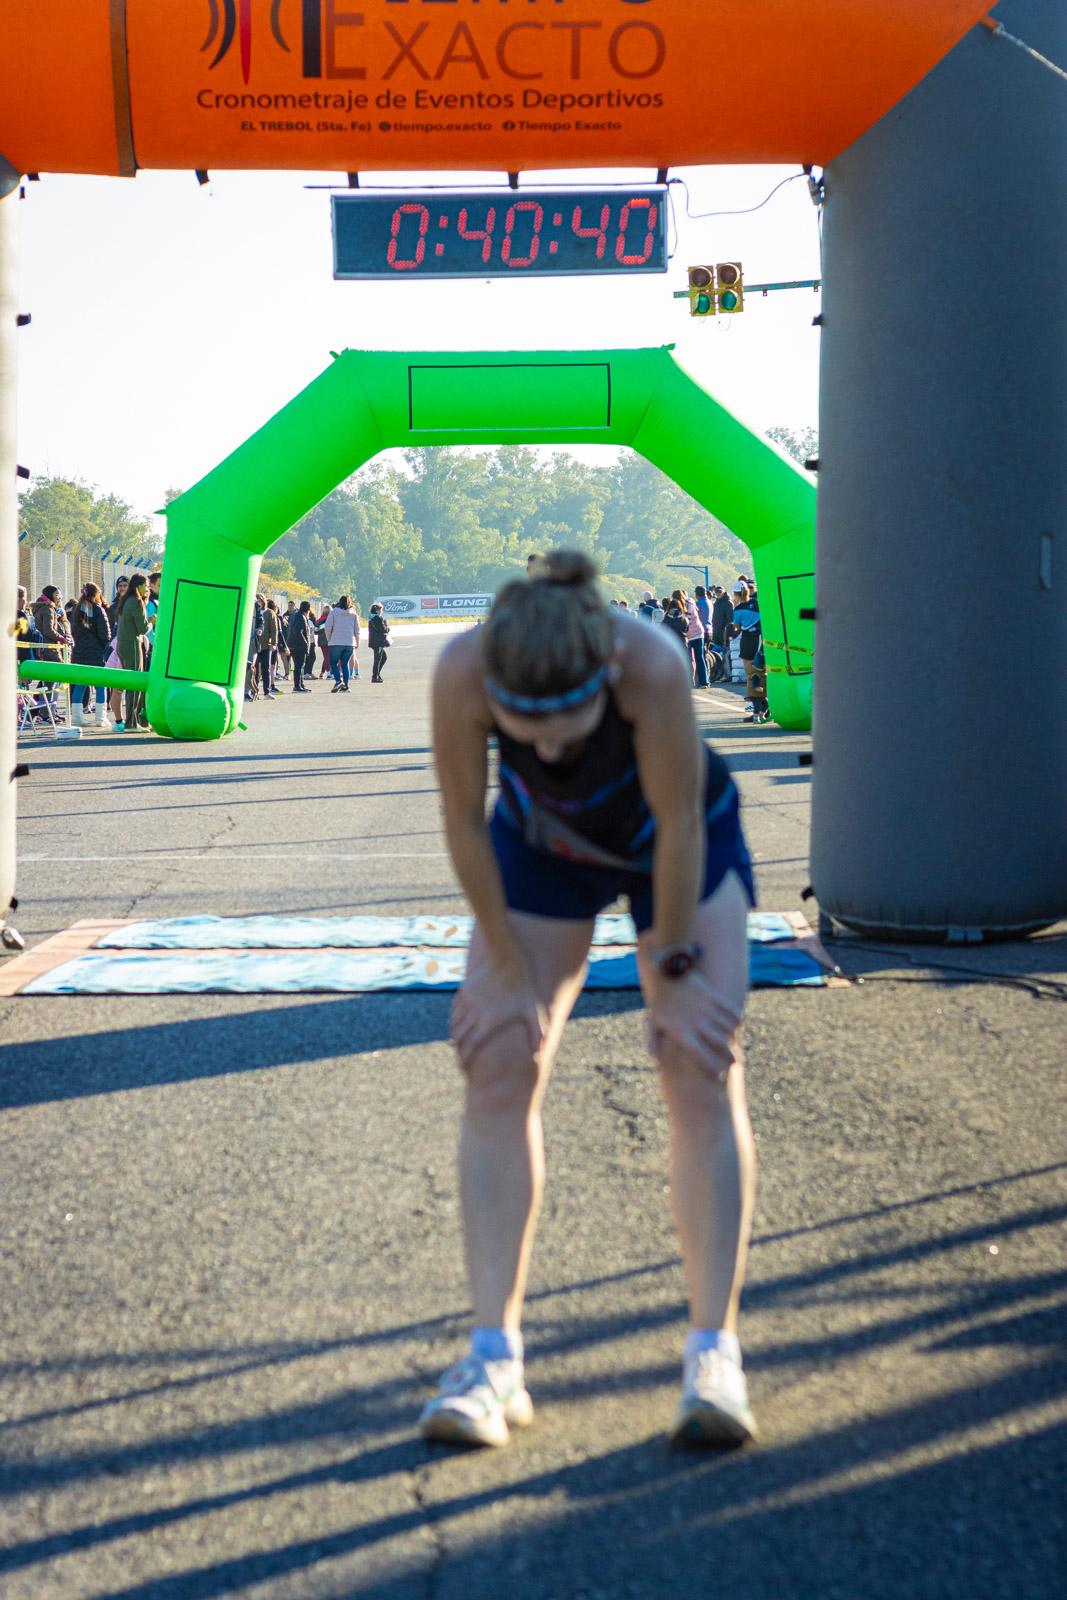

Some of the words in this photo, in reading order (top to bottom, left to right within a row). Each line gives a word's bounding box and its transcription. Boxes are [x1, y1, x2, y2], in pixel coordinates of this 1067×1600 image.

[325, 0, 666, 80] EXACTO
[197, 89, 368, 112] Cronometraje
[375, 89, 406, 109] de
[414, 89, 514, 109] Eventos
[523, 89, 664, 112] Deportivos
[240, 121, 257, 132] EL
[259, 121, 313, 132] TREBOL
[316, 121, 347, 133] (Sta.
[351, 121, 371, 132] Fe)
[393, 121, 492, 133] tiempo.exacto
[518, 120, 571, 131] Tiempo
[575, 120, 622, 131] Exacto
[387, 199, 658, 270] 0:40:40
[384, 600, 409, 612] Ford
[443, 598, 488, 607] LONG
